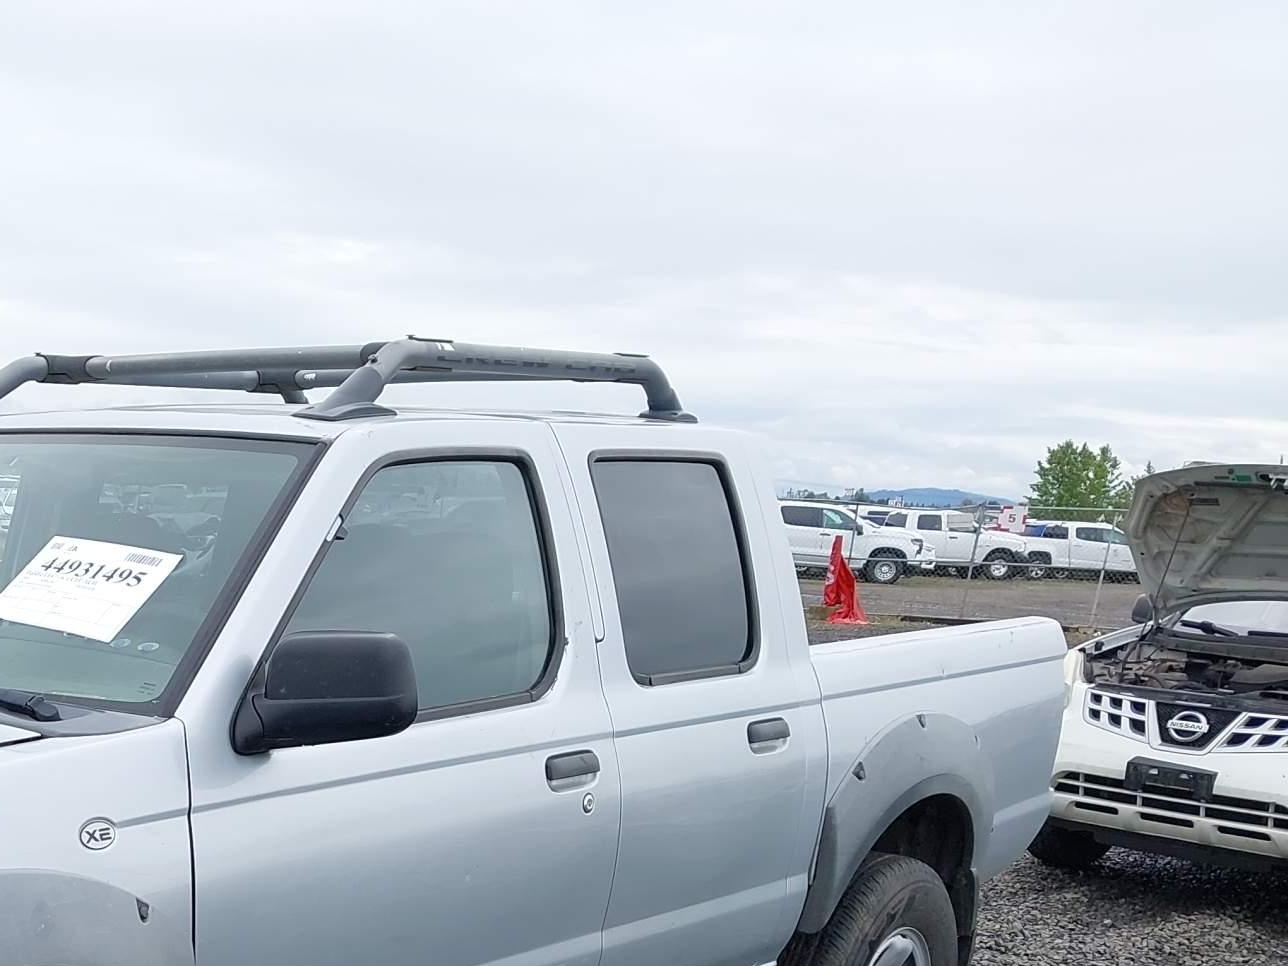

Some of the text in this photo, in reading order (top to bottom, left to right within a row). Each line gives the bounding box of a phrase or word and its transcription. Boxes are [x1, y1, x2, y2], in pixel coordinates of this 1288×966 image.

[1007, 513, 1017, 523] 5
[40, 557, 148, 587] 44931495
[1170, 721, 1204, 730] NISSAN
[84, 827, 112, 844] XE
